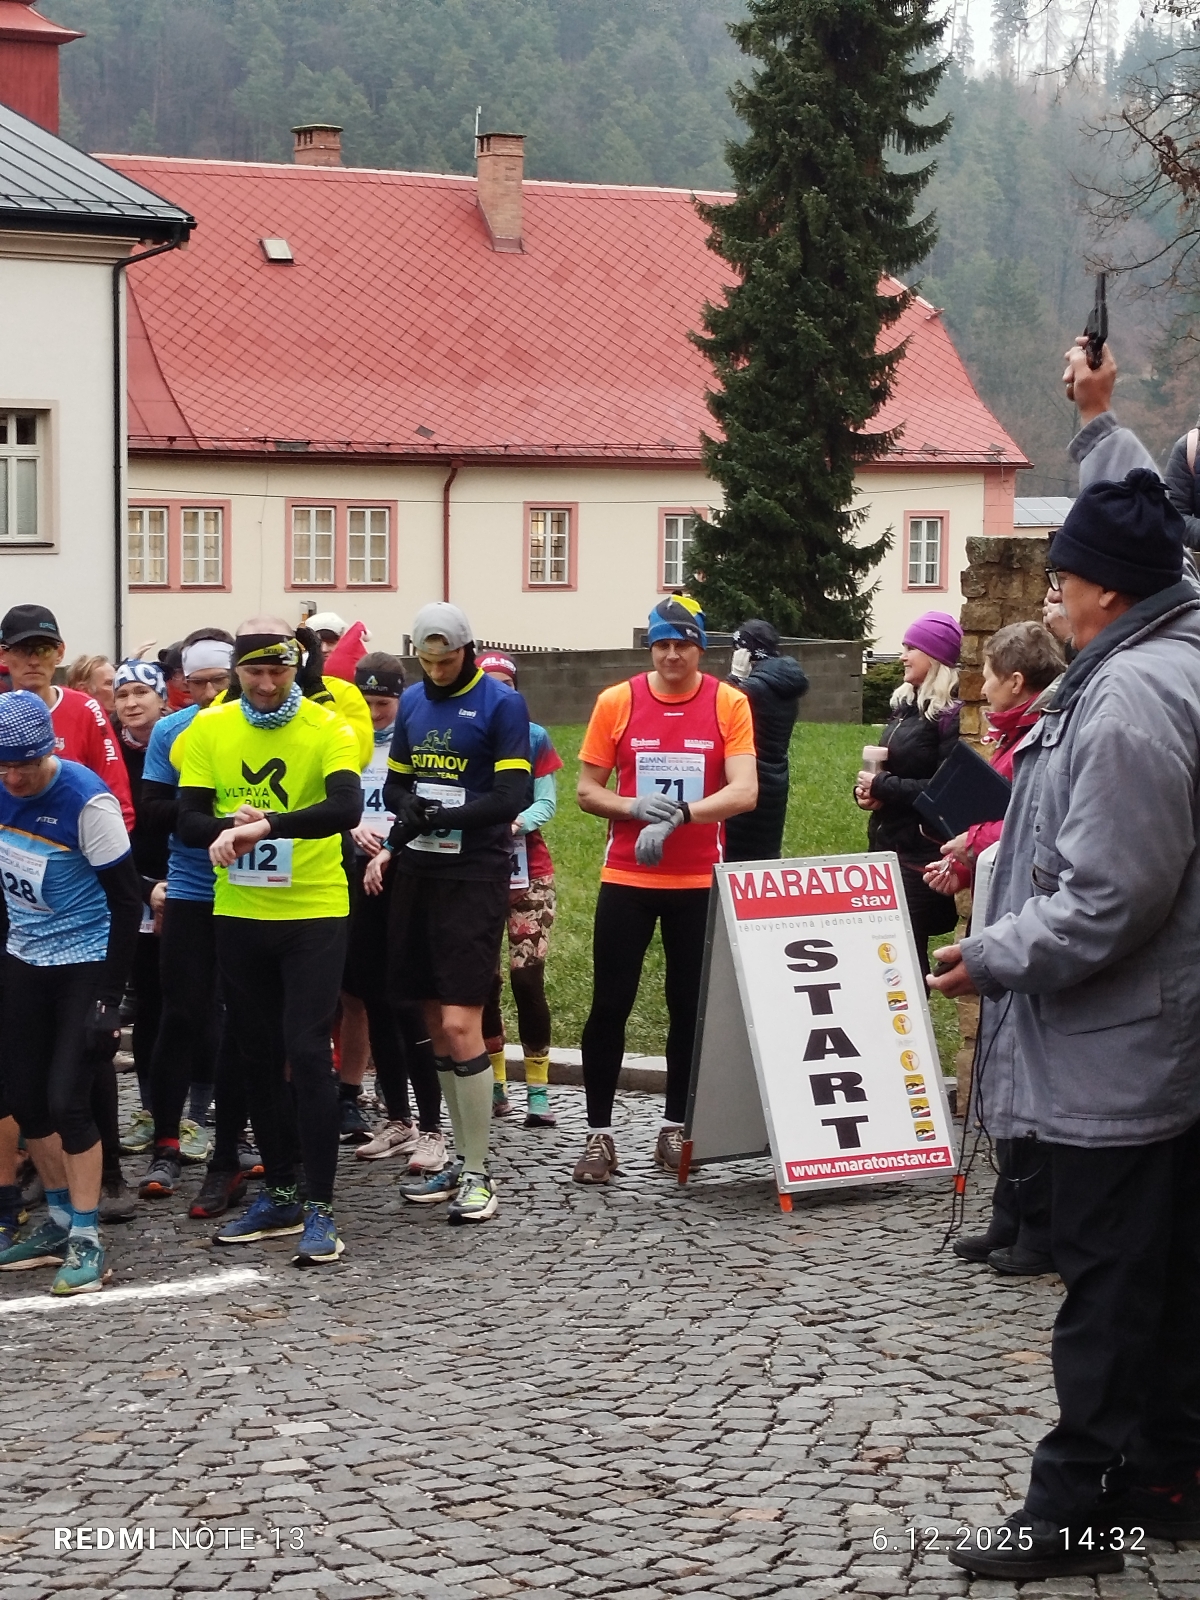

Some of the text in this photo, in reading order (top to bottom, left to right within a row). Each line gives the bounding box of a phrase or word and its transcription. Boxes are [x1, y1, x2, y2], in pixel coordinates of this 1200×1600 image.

[411, 754, 469, 772] RUTNOV
[224, 787, 270, 798] VLTAVA
[655, 778, 685, 802] 71
[728, 864, 890, 900] MARATON
[851, 895, 891, 908] stav
[739, 914, 900, 932] tělovýchovná jednota Úpice
[784, 938, 870, 1150] START
[791, 1151, 946, 1177] www.maratonstav.cz
